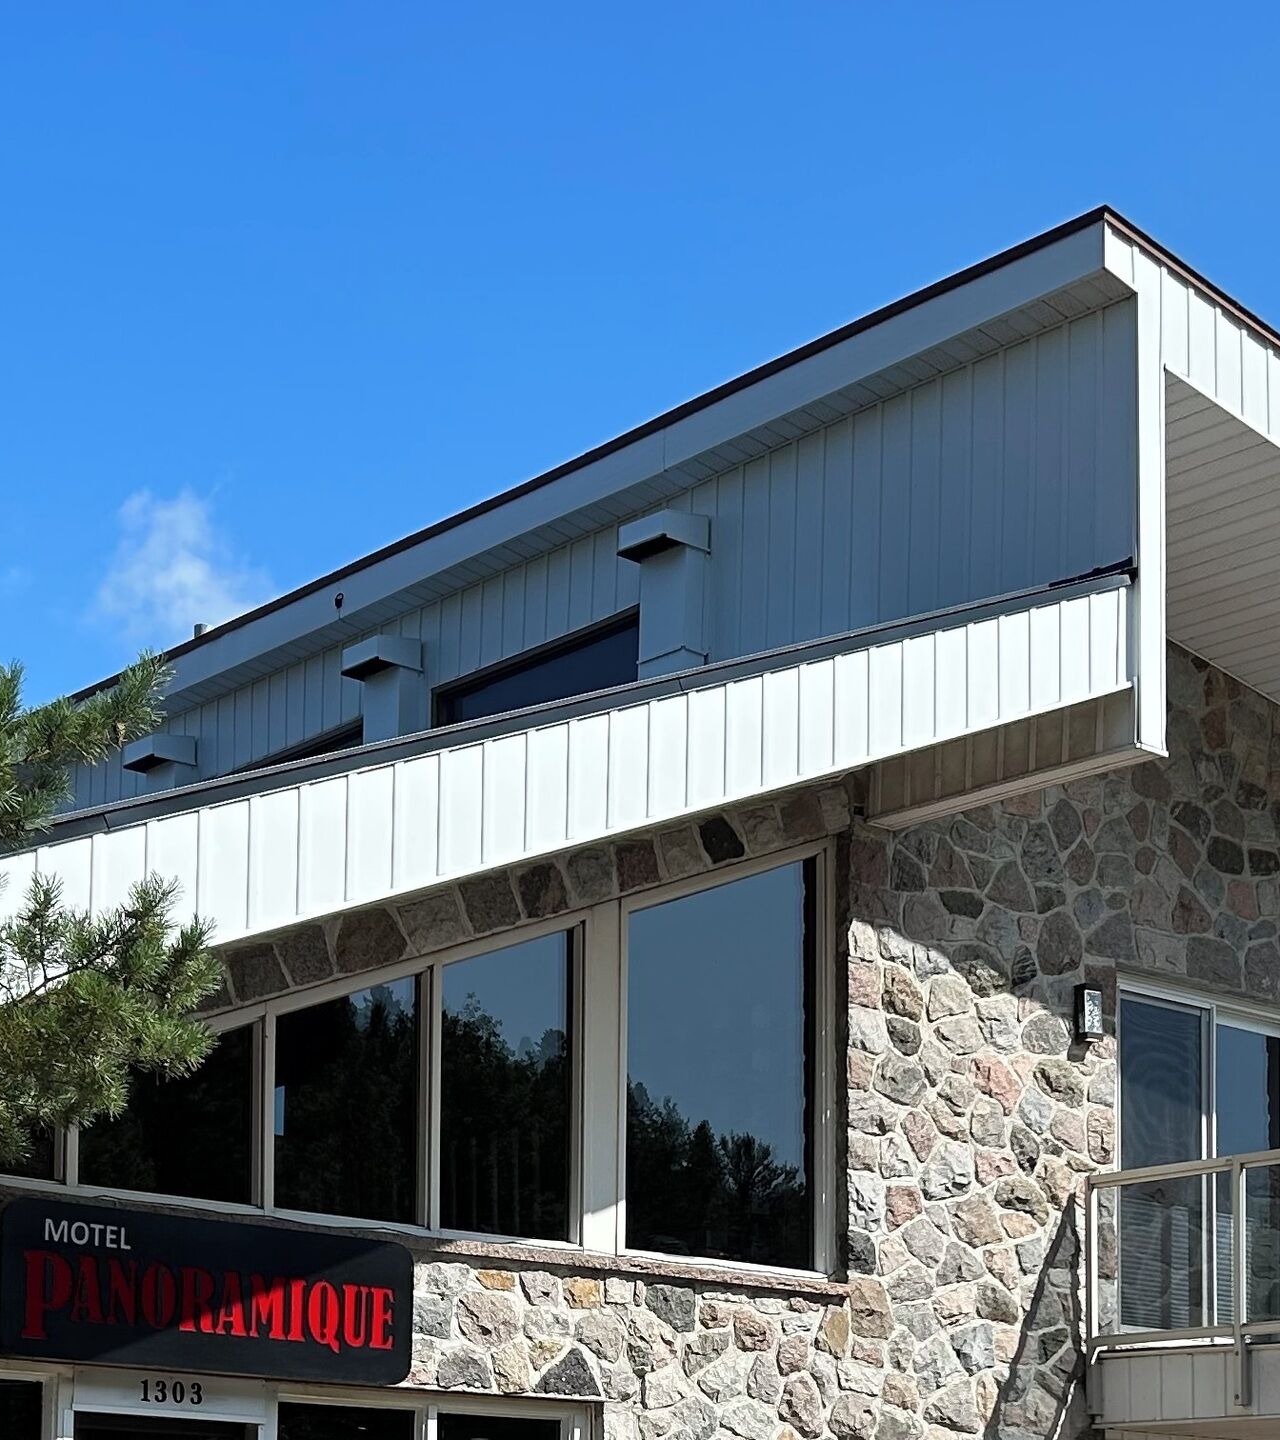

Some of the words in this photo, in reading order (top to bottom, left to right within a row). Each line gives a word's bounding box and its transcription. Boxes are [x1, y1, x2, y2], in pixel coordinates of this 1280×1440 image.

[44, 1218, 132, 1250] MOTEL
[21, 1250, 396, 1354] PANORAMIQUE
[140, 1379, 203, 1405] 1303
